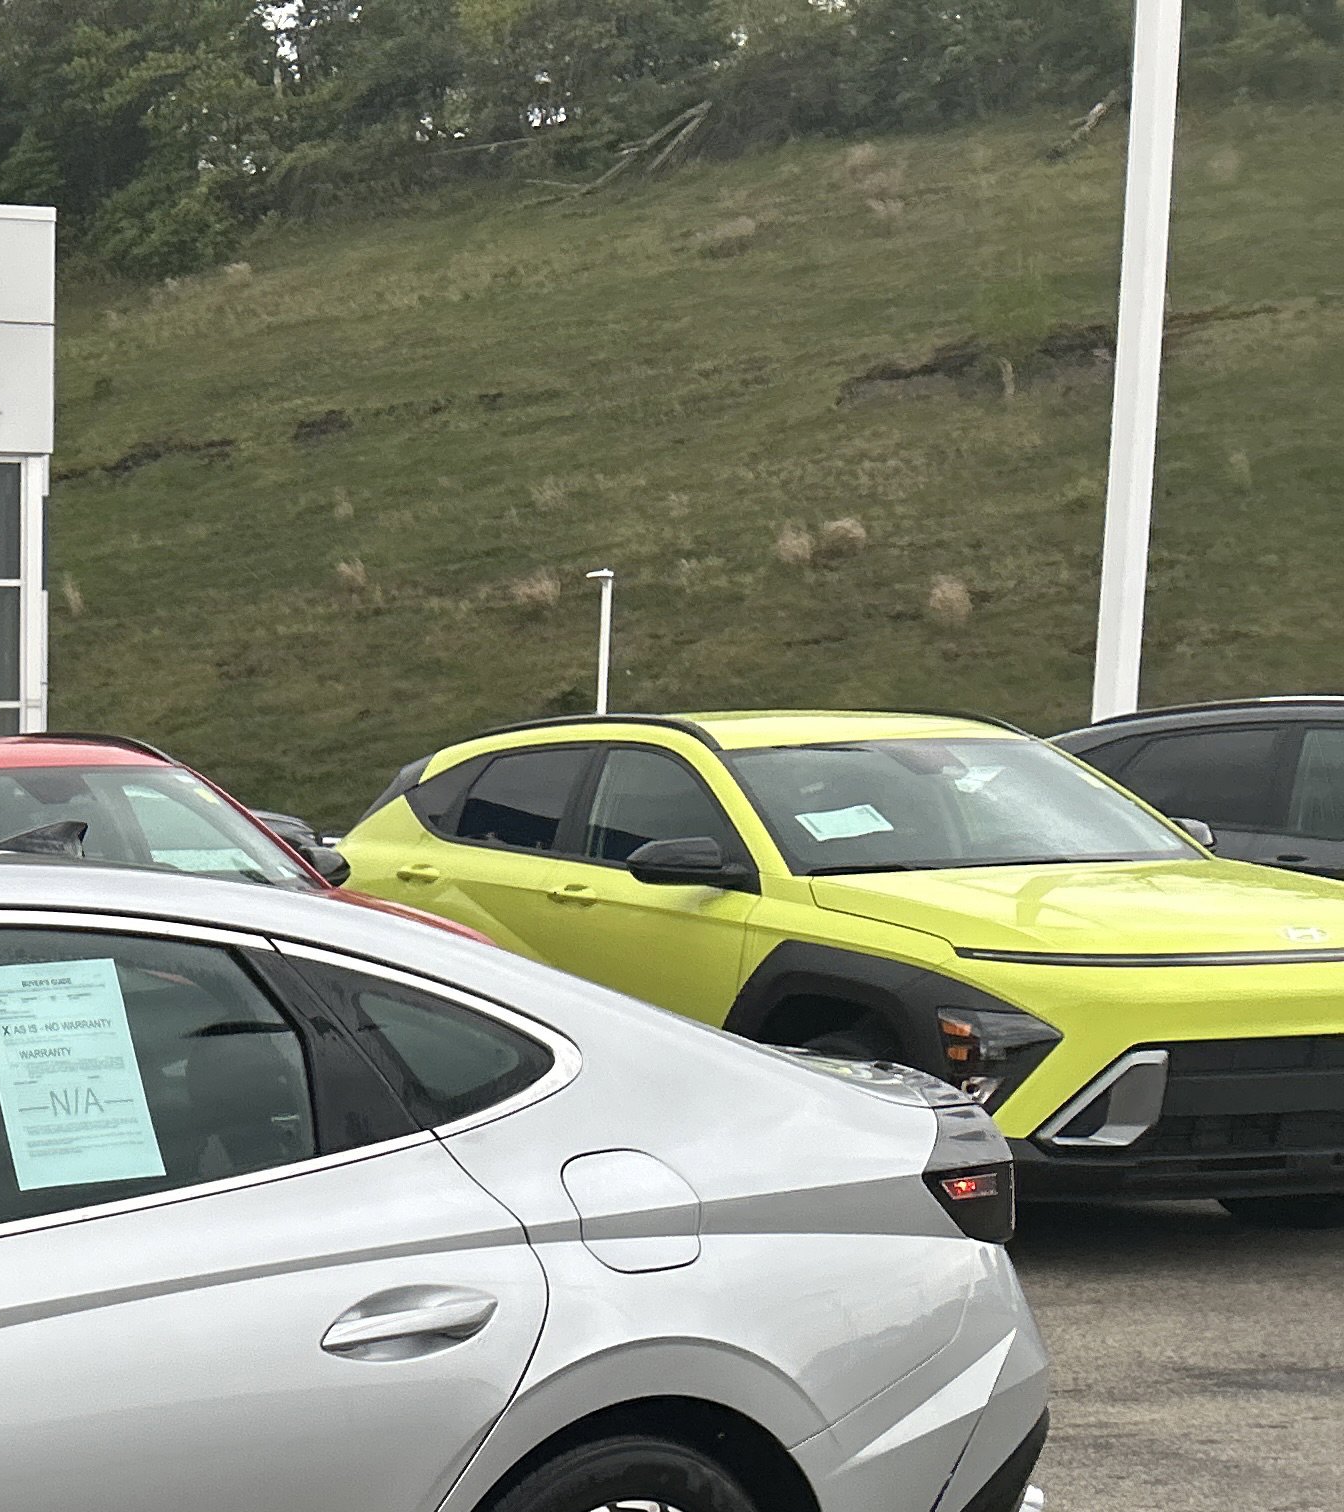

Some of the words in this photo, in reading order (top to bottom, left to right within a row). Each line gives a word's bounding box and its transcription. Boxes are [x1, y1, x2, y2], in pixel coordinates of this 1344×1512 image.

[2, 1025, 11, 1036] X
[13, 1024, 27, 1035] AS
[44, 1021, 60, 1031] NO
[61, 1018, 112, 1030] WARRANTY
[18, 1046, 72, 1060] WARRANTY
[49, 1087, 105, 1117] N/A
